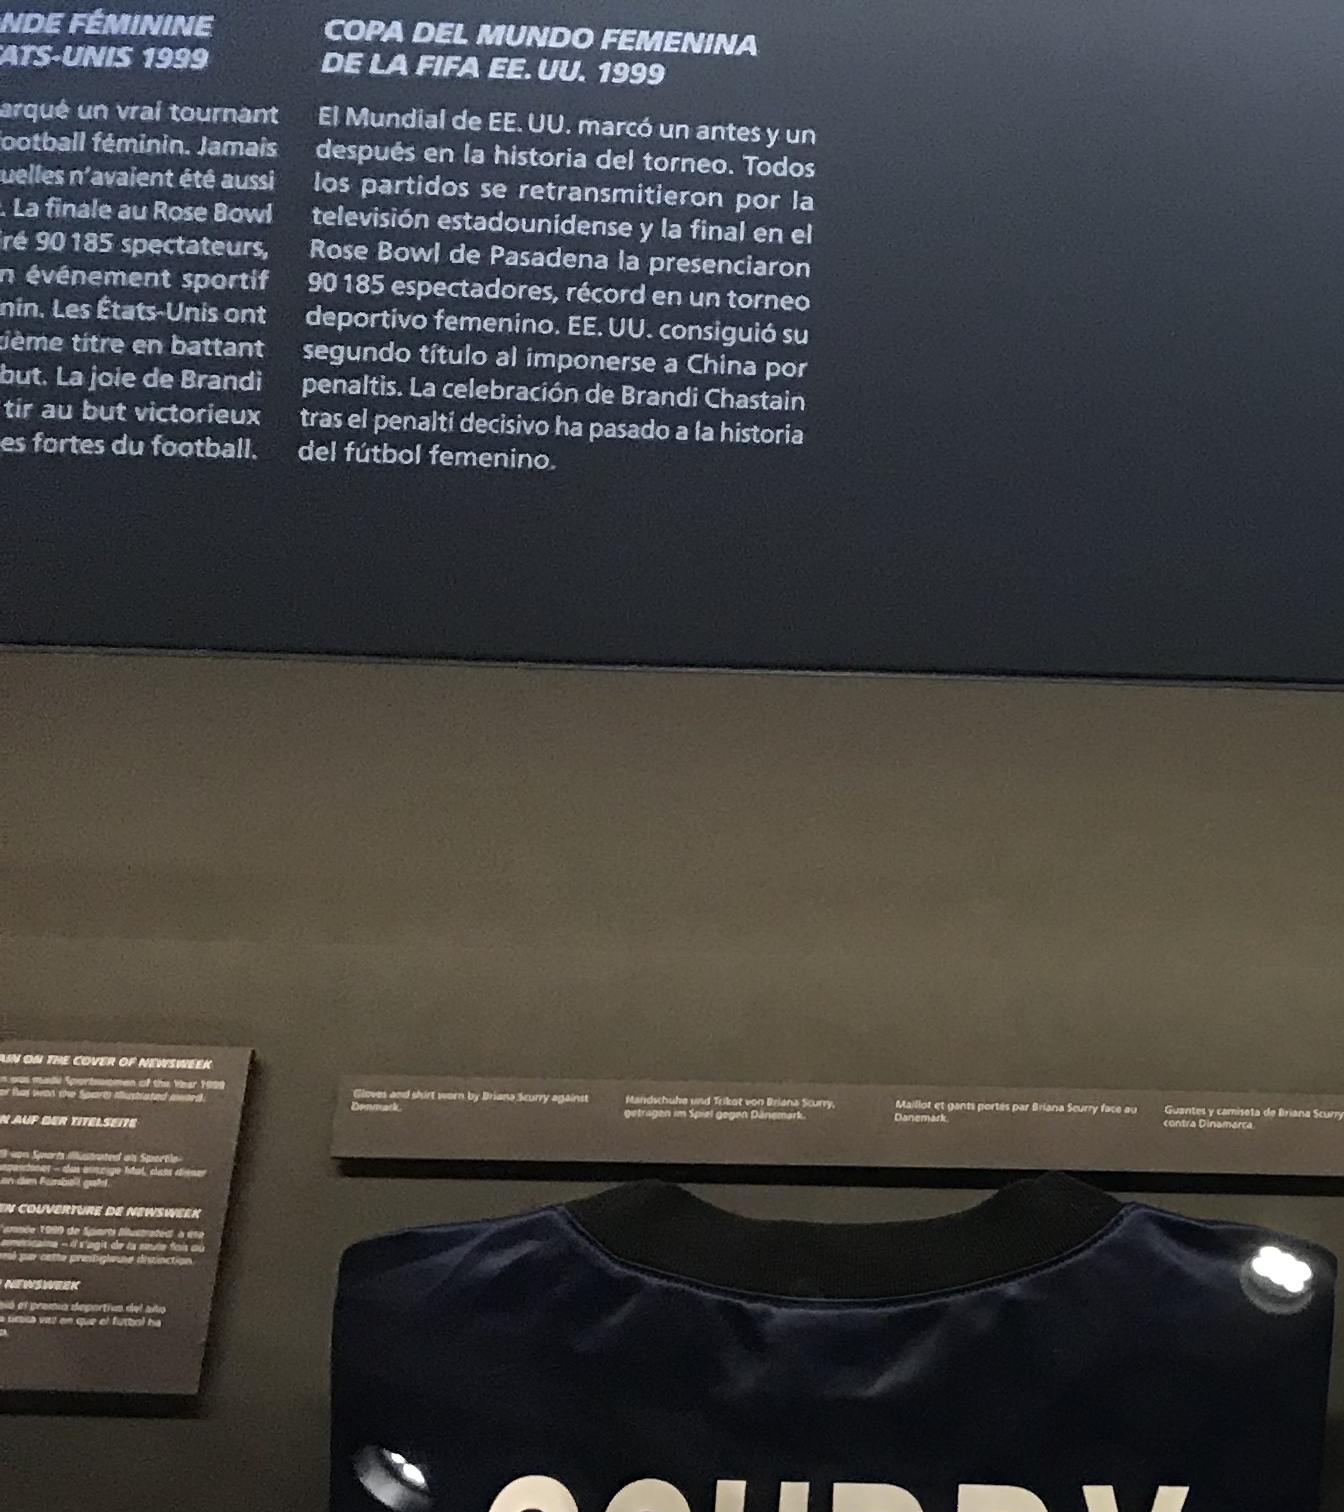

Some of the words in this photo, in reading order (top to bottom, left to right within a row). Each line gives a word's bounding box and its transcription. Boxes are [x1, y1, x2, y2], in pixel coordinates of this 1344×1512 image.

[323, 18, 404, 43] COPA
[411, 21, 468, 45] DEL
[475, 23, 594, 49] MUNDO
[599, 27, 757, 56] FEMENINA
[320, 51, 364, 74] DE
[368, 52, 408, 76] LA
[414, 54, 479, 78] FIFA
[597, 60, 665, 85] 1999
